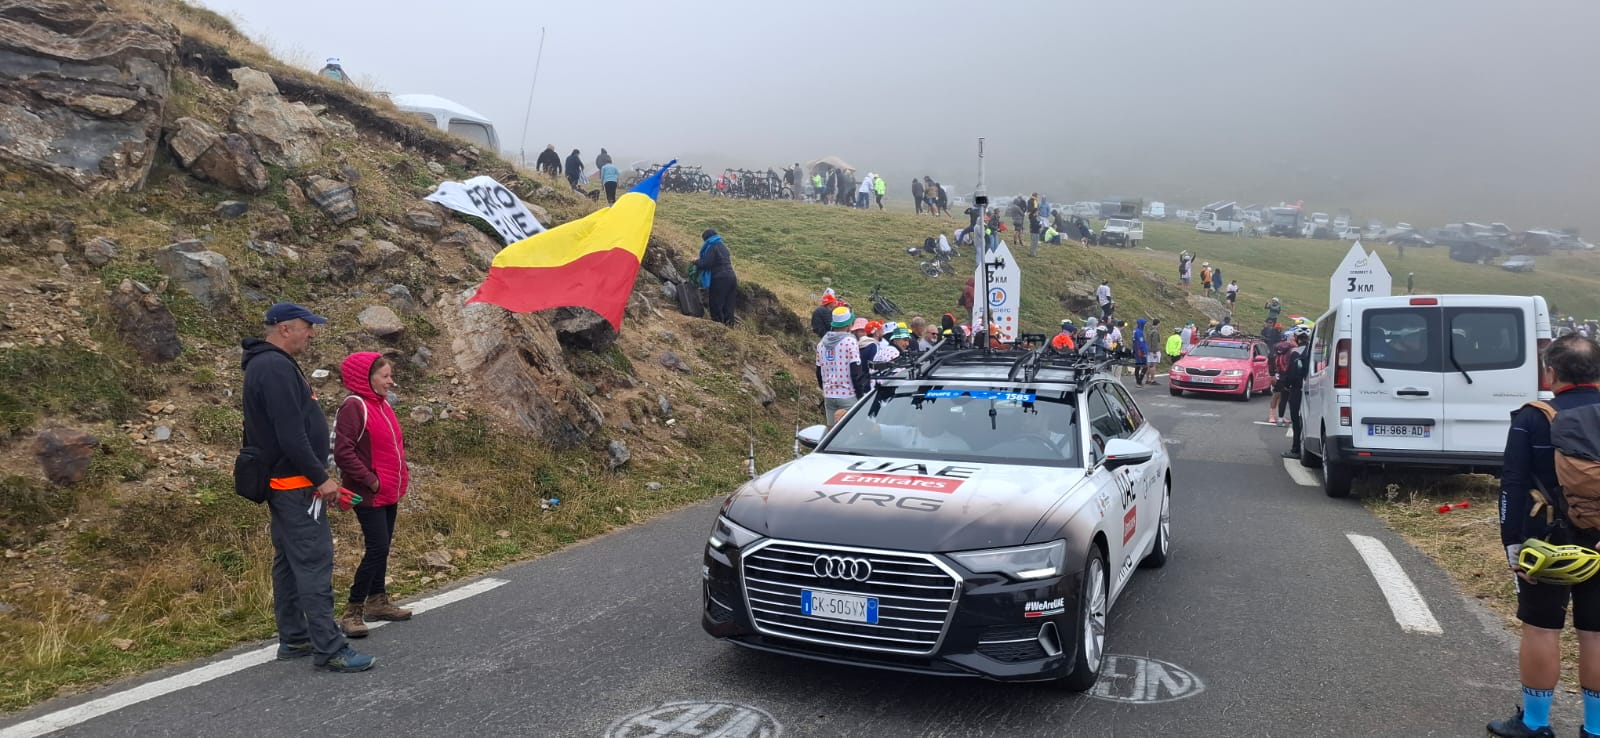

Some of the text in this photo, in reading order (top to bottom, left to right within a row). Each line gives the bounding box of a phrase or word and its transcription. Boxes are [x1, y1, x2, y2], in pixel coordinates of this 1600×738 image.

[1347, 277, 1374, 293] 3 KM
[1005, 393, 1030, 401] 1585
[1375, 425, 1423, 435] EH-968-AD
[846, 460, 981, 479] UAE
[840, 474, 947, 489] Emirates
[804, 490, 945, 513] XRG
